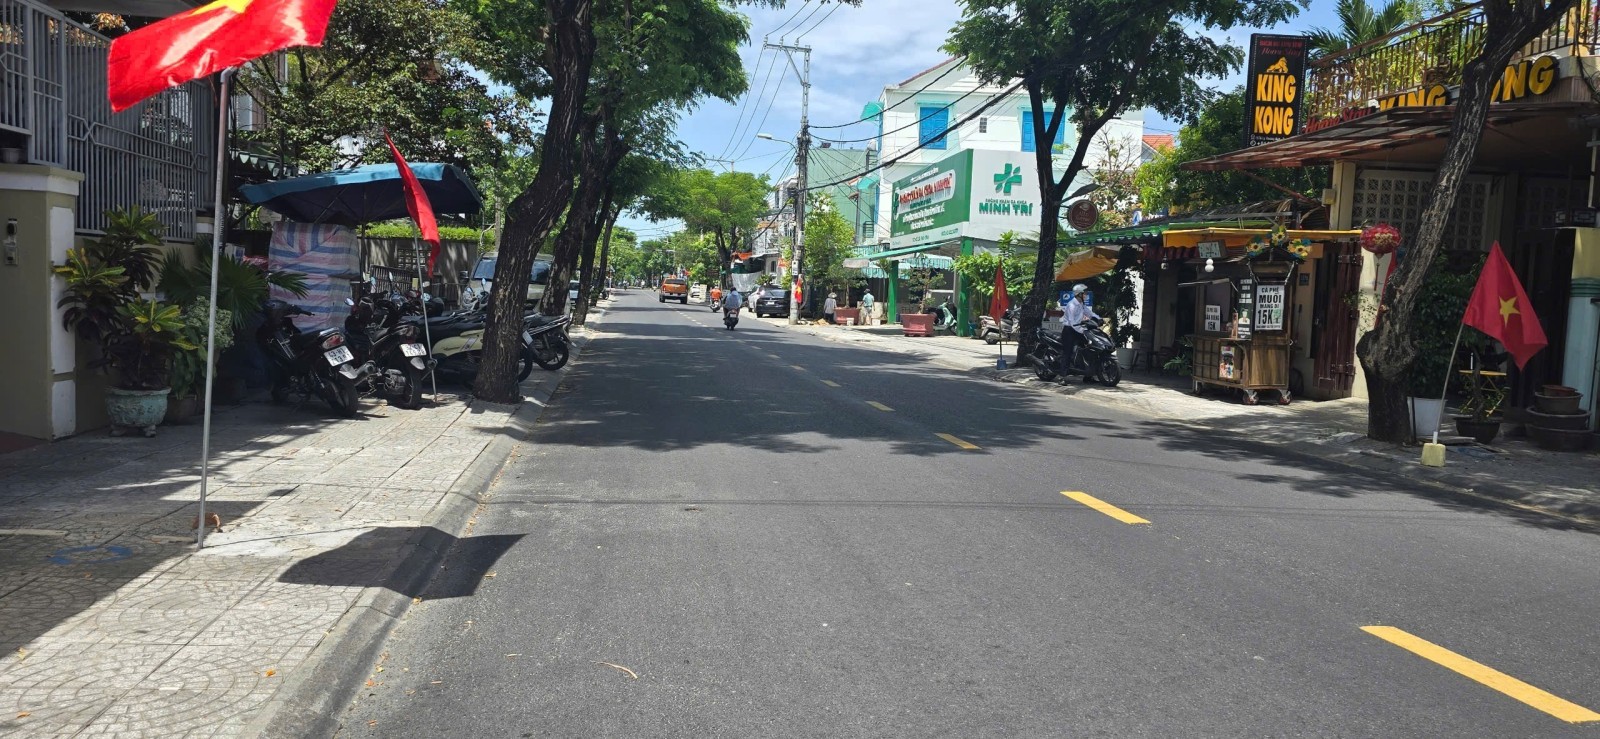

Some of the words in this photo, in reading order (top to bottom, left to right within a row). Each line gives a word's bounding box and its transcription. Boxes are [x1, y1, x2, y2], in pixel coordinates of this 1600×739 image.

[1256, 73, 1297, 104] KING
[1254, 106, 1294, 135] KONG
[979, 202, 1010, 214] MINH
[1257, 309, 1274, 325] 15K
